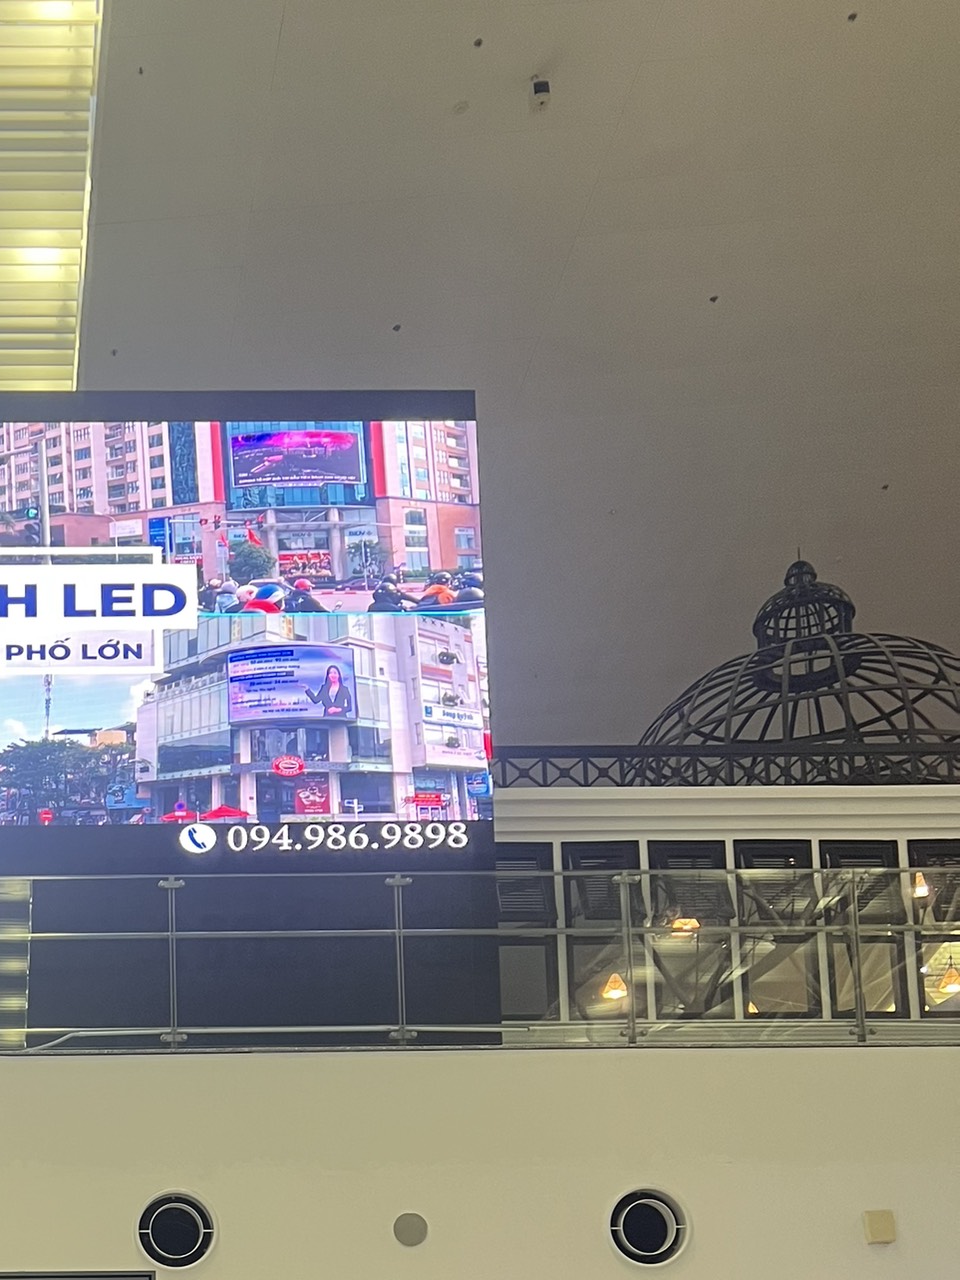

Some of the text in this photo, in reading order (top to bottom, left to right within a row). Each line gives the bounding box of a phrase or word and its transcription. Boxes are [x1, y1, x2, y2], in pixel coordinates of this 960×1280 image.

[63, 583, 187, 617] LED
[5, 637, 71, 660] PHỐ
[81, 638, 143, 660] LỚN
[227, 822, 469, 851] 094.986.9898
